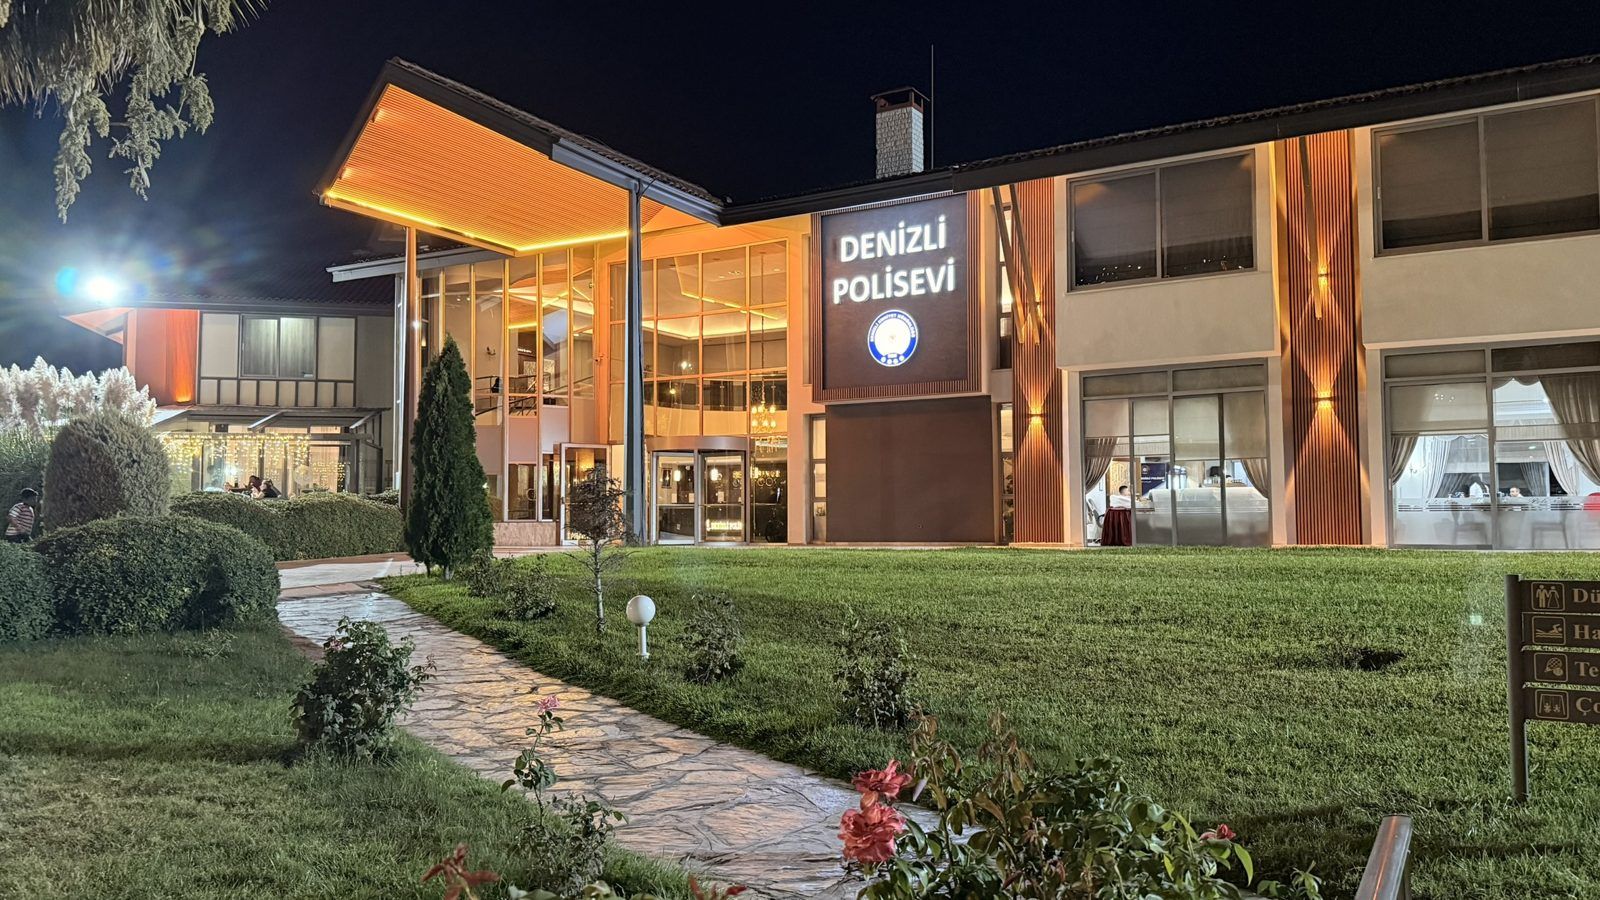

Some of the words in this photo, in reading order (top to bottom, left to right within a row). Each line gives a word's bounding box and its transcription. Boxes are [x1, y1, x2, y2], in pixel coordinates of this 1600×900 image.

[840, 214, 947, 263] DENİZLİ
[832, 256, 955, 305] POLİSEVİ
[1574, 661, 1600, 678] Te
